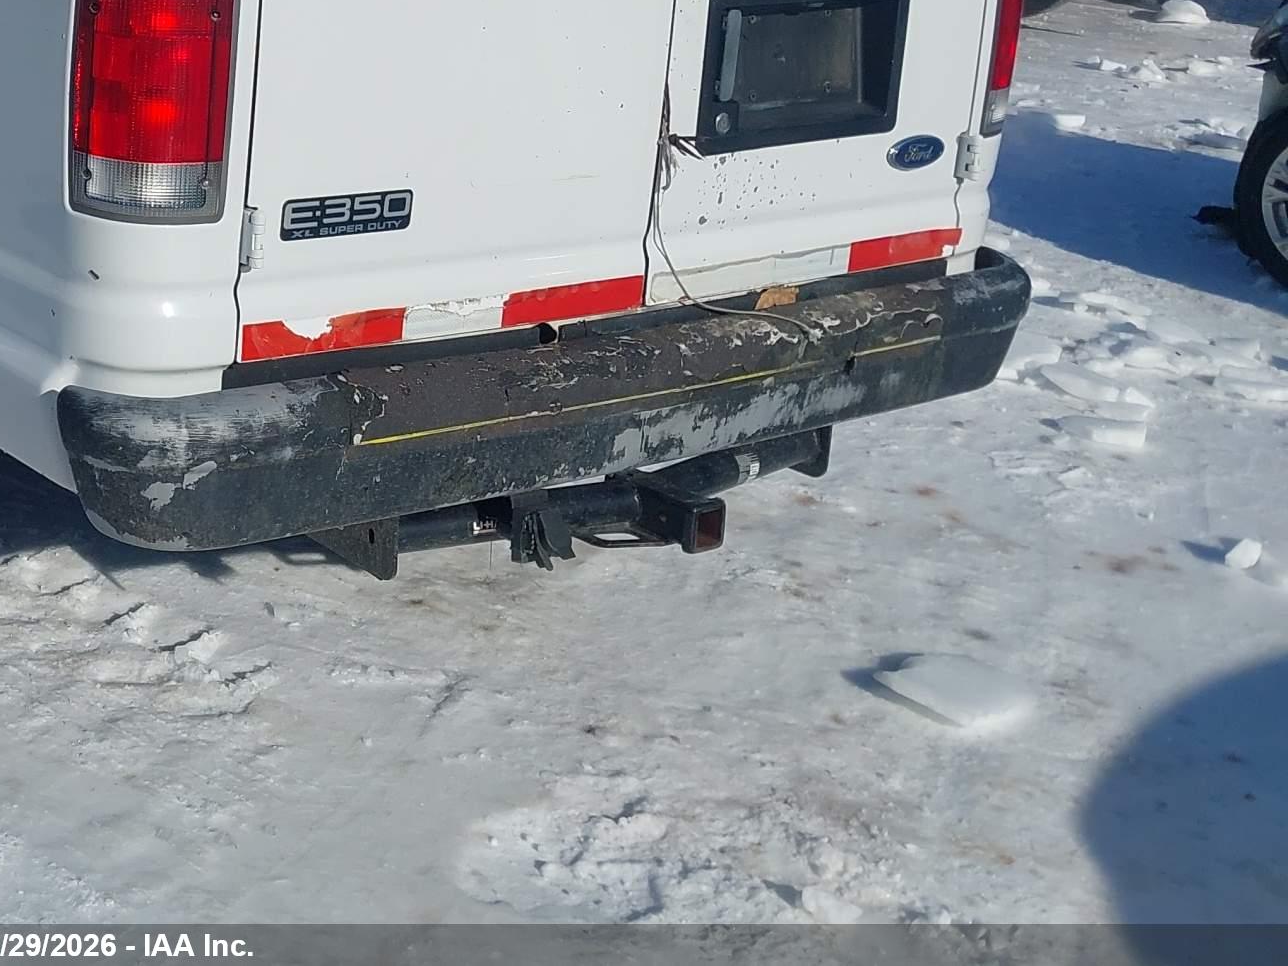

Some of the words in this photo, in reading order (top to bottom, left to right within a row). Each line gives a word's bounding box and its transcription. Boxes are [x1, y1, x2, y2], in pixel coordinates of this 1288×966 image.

[903, 143, 934, 163] Ford
[290, 229, 314, 239] XL
[319, 224, 363, 236] SUPER
[367, 219, 403, 231] DUTY
